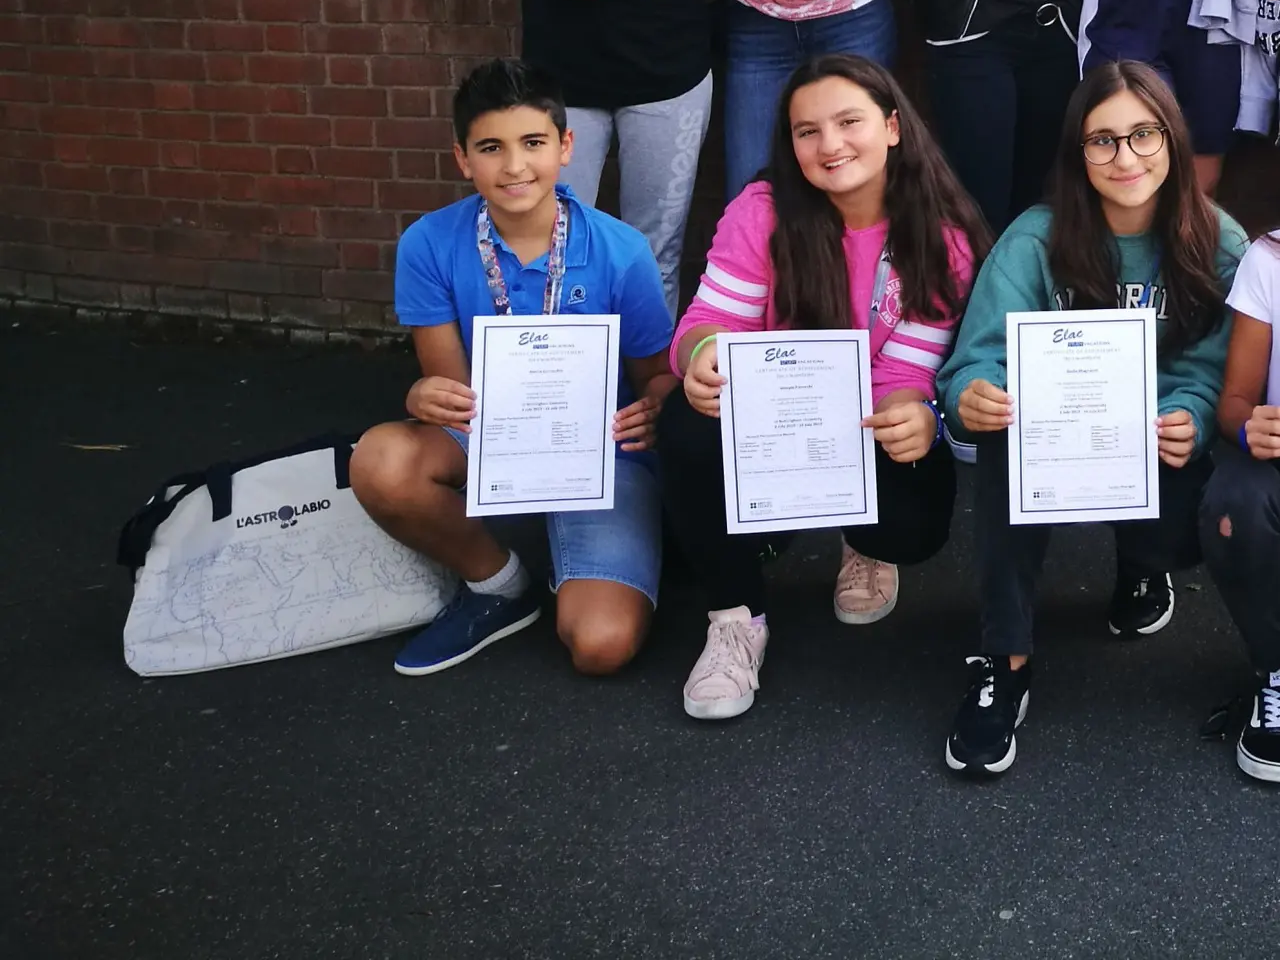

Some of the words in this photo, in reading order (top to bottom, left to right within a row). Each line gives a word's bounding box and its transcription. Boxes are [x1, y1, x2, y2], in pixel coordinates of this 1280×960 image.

[518, 332, 549, 346] Elac
[1053, 328, 1084, 343] Elac
[765, 347, 796, 362] Elac
